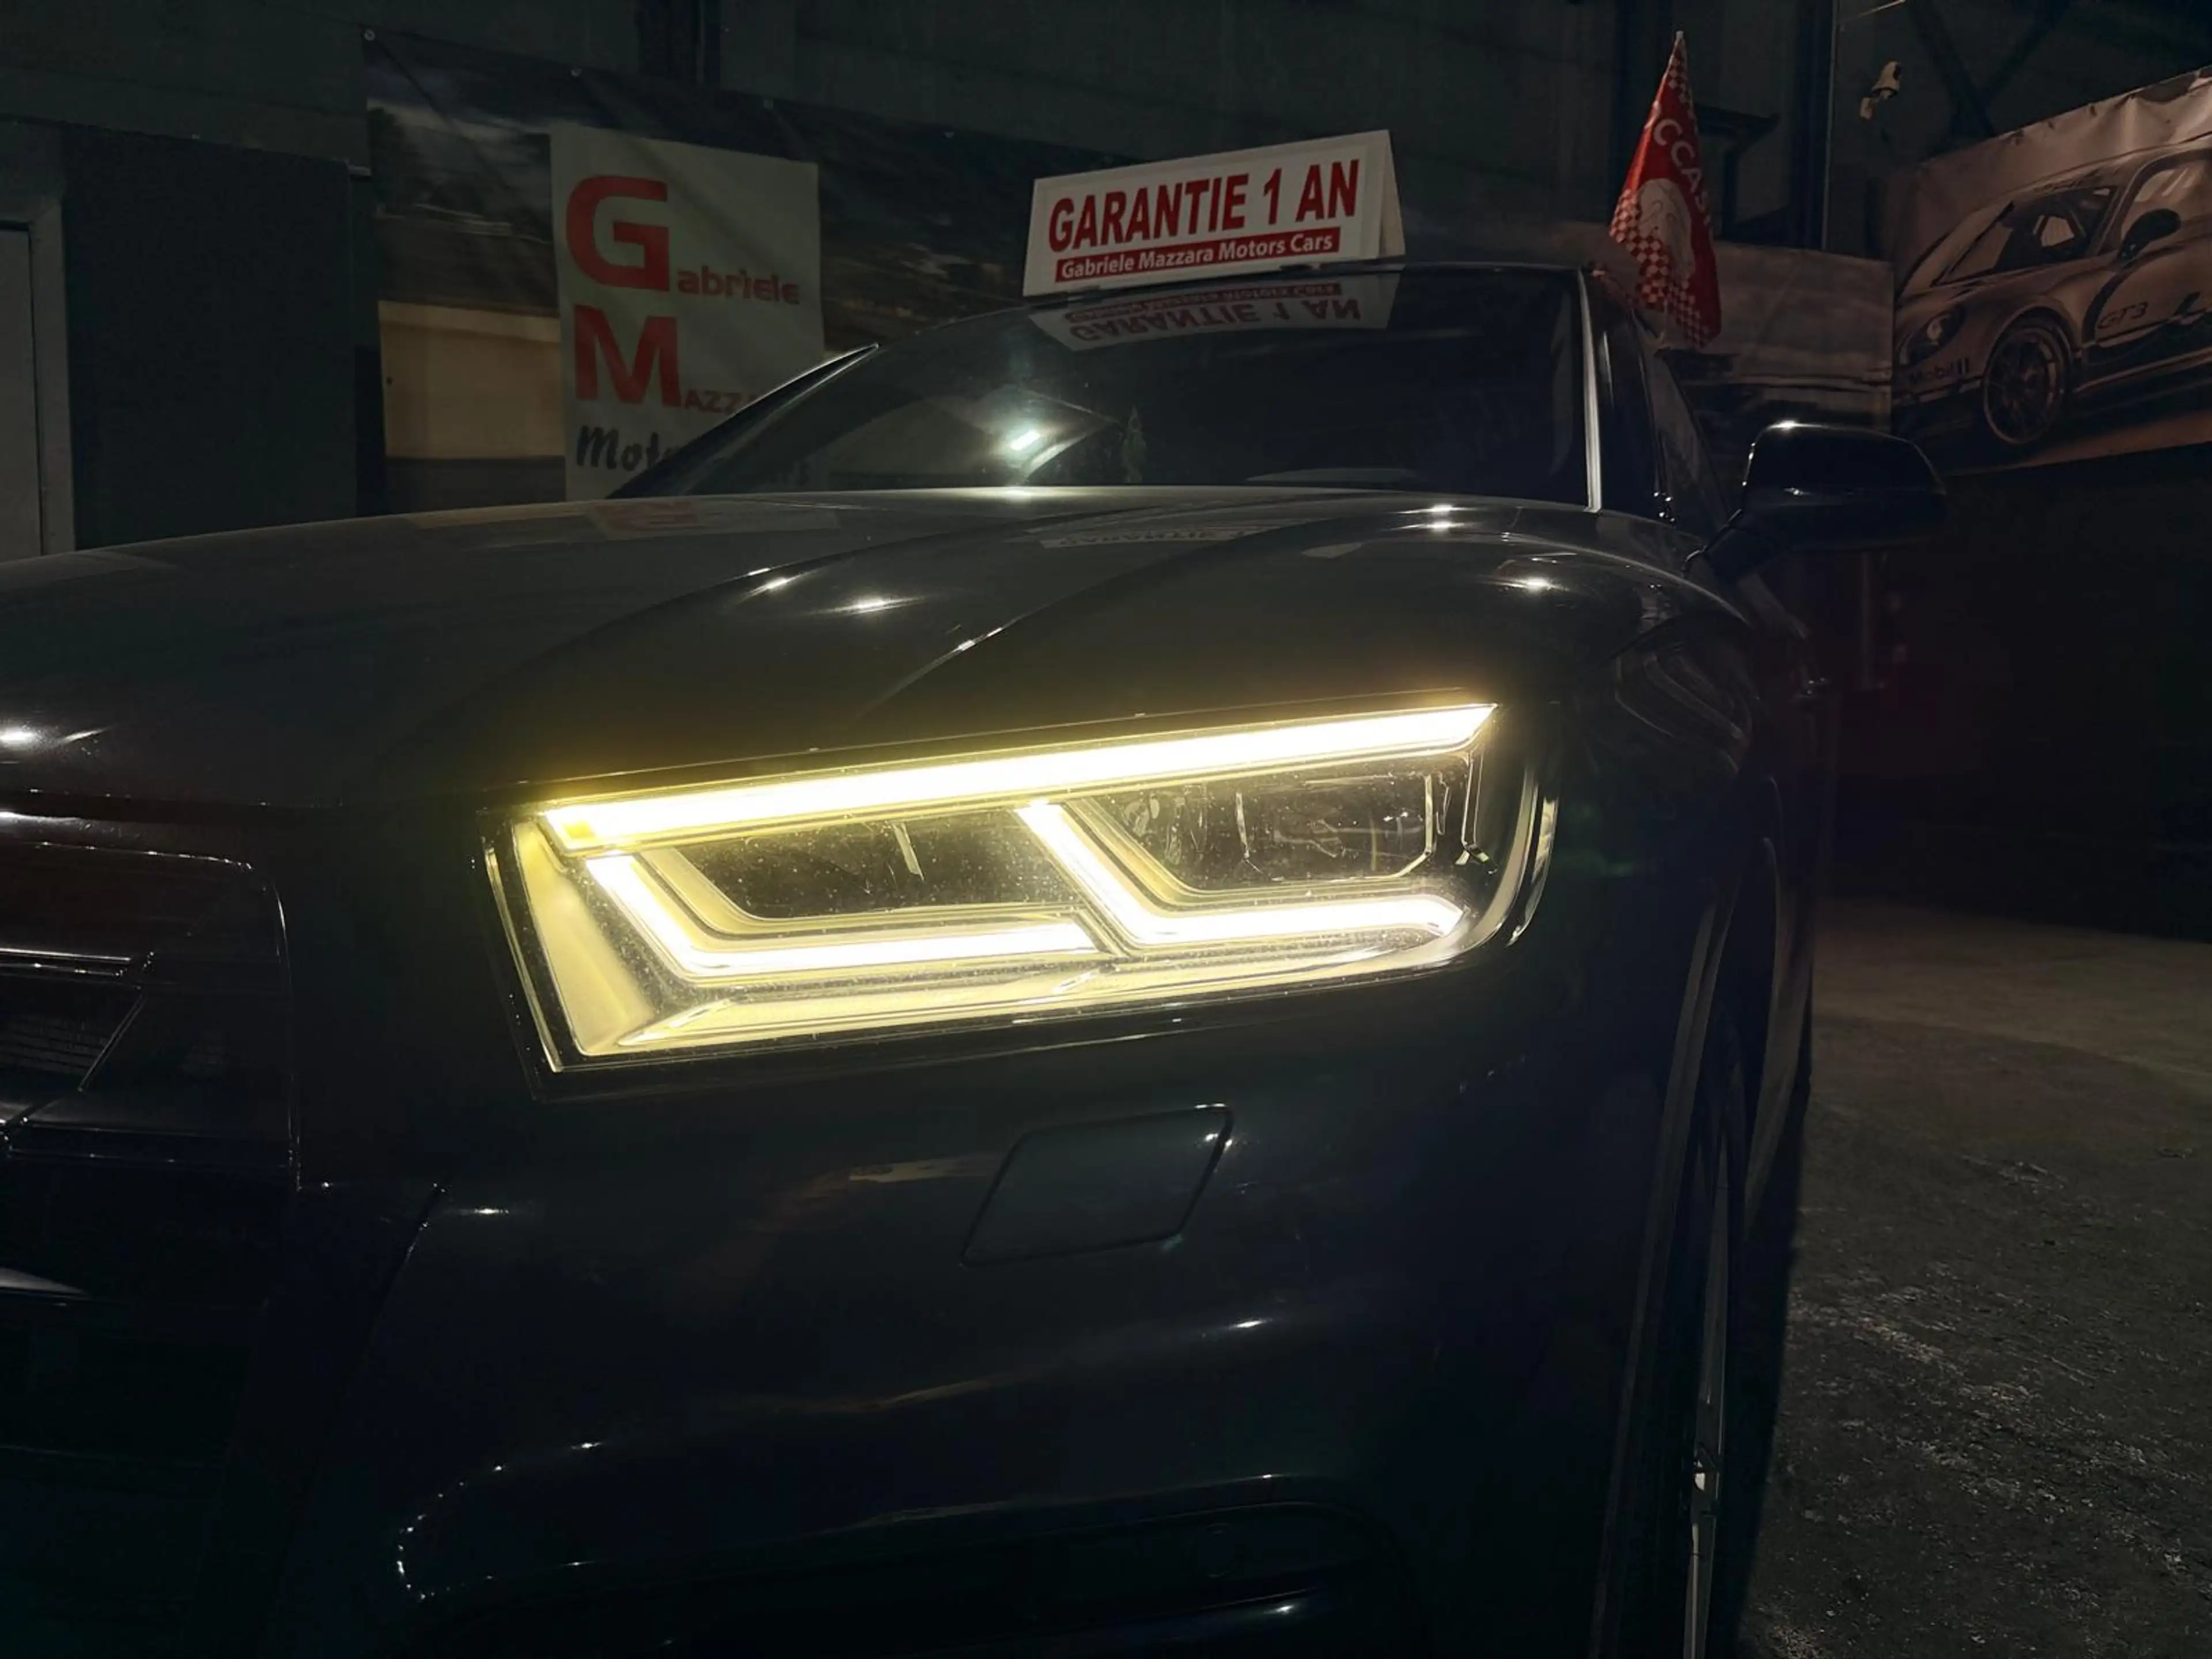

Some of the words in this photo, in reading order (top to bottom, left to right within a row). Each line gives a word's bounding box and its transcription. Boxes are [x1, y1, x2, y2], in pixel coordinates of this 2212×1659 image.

[566, 175, 800, 305] Gabriele
[1048, 174, 1249, 252] GARANTIE
[1263, 168, 1282, 225] 1
[1296, 159, 1359, 222] AN
[1061, 253, 1134, 279] Gabriele
[1138, 247, 1213, 270] Mazzara
[1218, 238, 1285, 261] Motors
[1290, 233, 1334, 253] Cars
[574, 304, 763, 414] MAZZ
[576, 425, 681, 471] Mot
